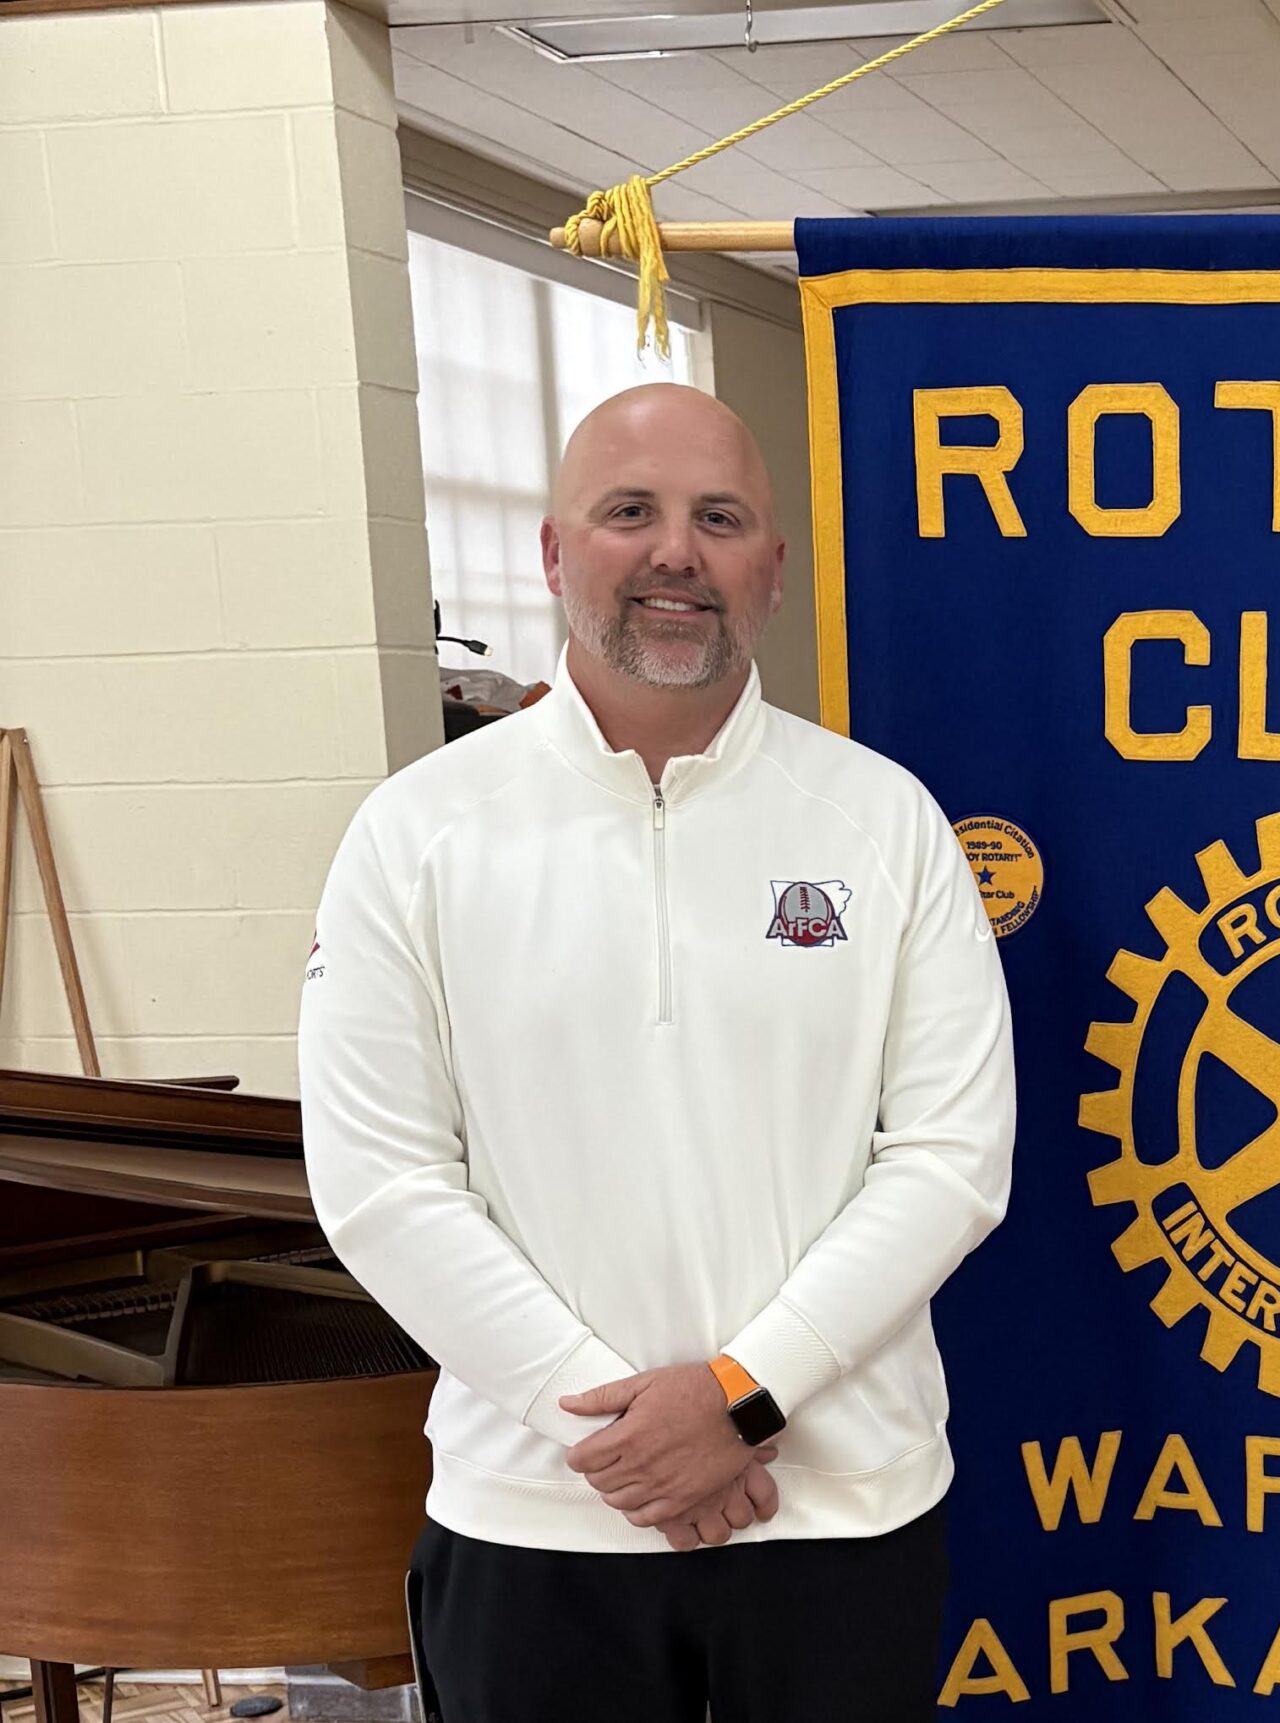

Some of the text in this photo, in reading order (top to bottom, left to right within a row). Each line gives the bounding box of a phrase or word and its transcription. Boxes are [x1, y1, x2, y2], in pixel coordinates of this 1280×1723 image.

[954, 819, 1035, 859] esidential Citation
[966, 840, 1003, 850] 1989-90
[766, 917, 849, 941] ArFCA
